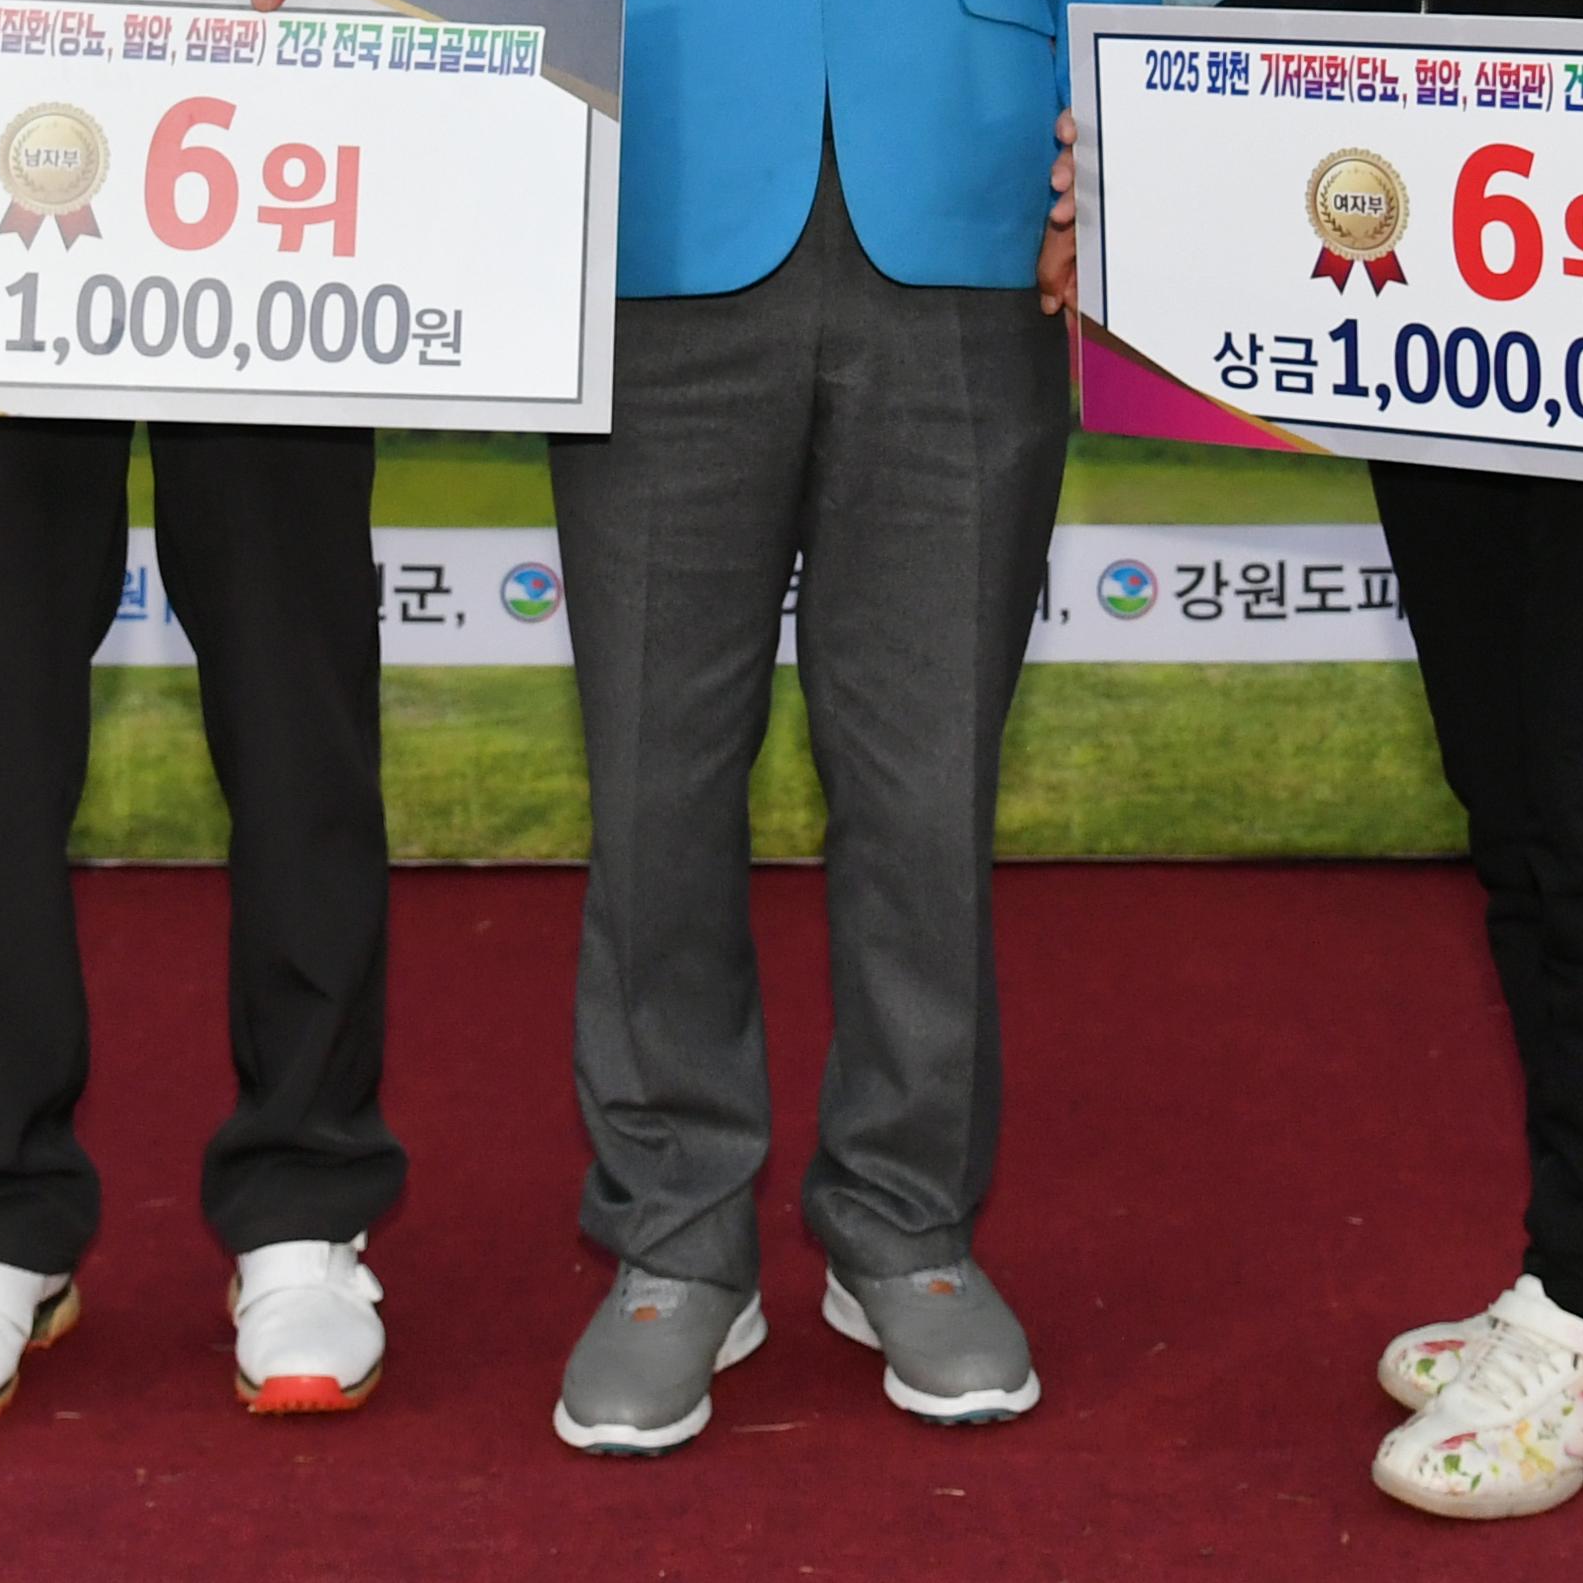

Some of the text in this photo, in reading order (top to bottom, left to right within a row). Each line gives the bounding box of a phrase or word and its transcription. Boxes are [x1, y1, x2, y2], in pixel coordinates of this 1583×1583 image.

[122, 13, 176, 66] 혈압,
[185, 16, 267, 66] 심혈관)
[276, 20, 327, 68] 건강
[333, 22, 383, 71] 전국
[388, 25, 540, 76] 파크골프대회
[1145, 49, 1200, 93] 2025
[1206, 51, 1250, 96] 화천
[1259, 52, 1408, 110] 기저질환(당뇨,
[1415, 58, 1467, 112] 혈압,
[1475, 61, 1554, 113] 심혈관)
[24, 148, 81, 168] 남자부
[144, 96, 361, 258] 6위
[1333, 193, 1385, 215] 여자부
[4, 271, 464, 371] 1,000,000원
[1213, 330, 1319, 395] 상금
[374, 561, 466, 628] 군,
